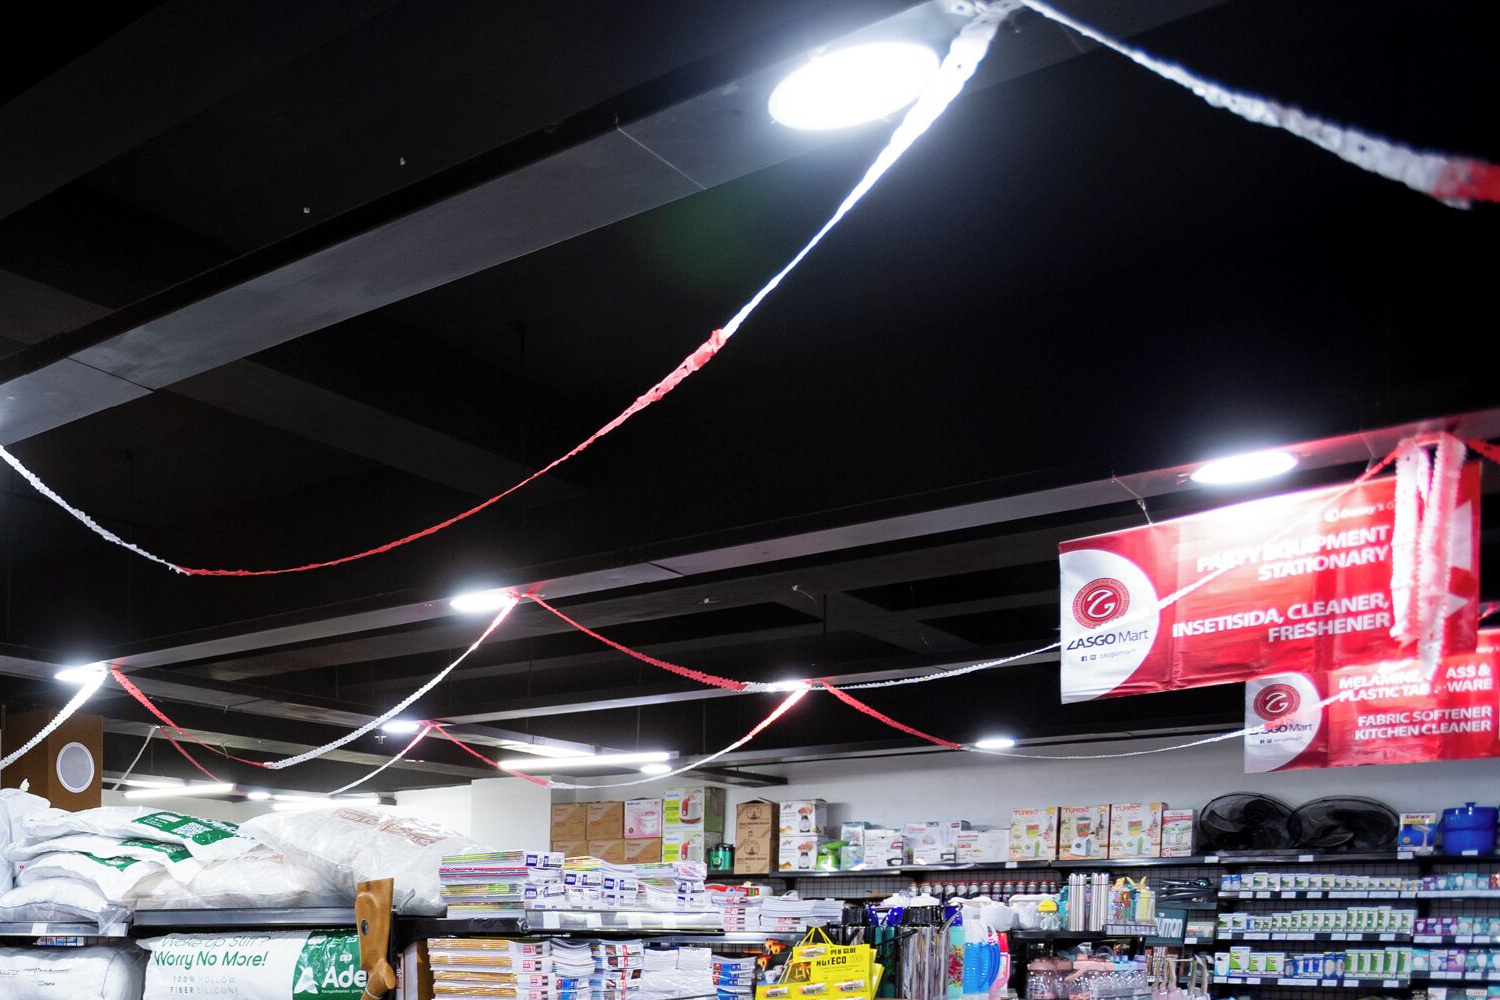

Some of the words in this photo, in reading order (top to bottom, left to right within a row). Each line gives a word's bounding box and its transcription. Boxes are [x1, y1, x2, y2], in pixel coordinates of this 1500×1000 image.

[1257, 545, 1389, 581] STATIONARY
[1172, 608, 1284, 638] INSETISIDA,
[1287, 592, 1390, 620] CLEANER,
[1118, 630, 1149, 645] Mart
[1267, 613, 1390, 643] FRESHENER
[1476, 664, 1490, 677] &
[1339, 685, 1402, 702] PLASTIC
[1358, 712, 1409, 726] FABRIC
[1412, 706, 1492, 721] SOFTENER
[1289, 722, 1313, 732] Mart
[1355, 725, 1419, 740] KITCHEN
[1421, 720, 1491, 734] CLEANER
[155, 951, 192, 970] Worry
[197, 951, 217, 966] No
[225, 951, 268, 967] More!
